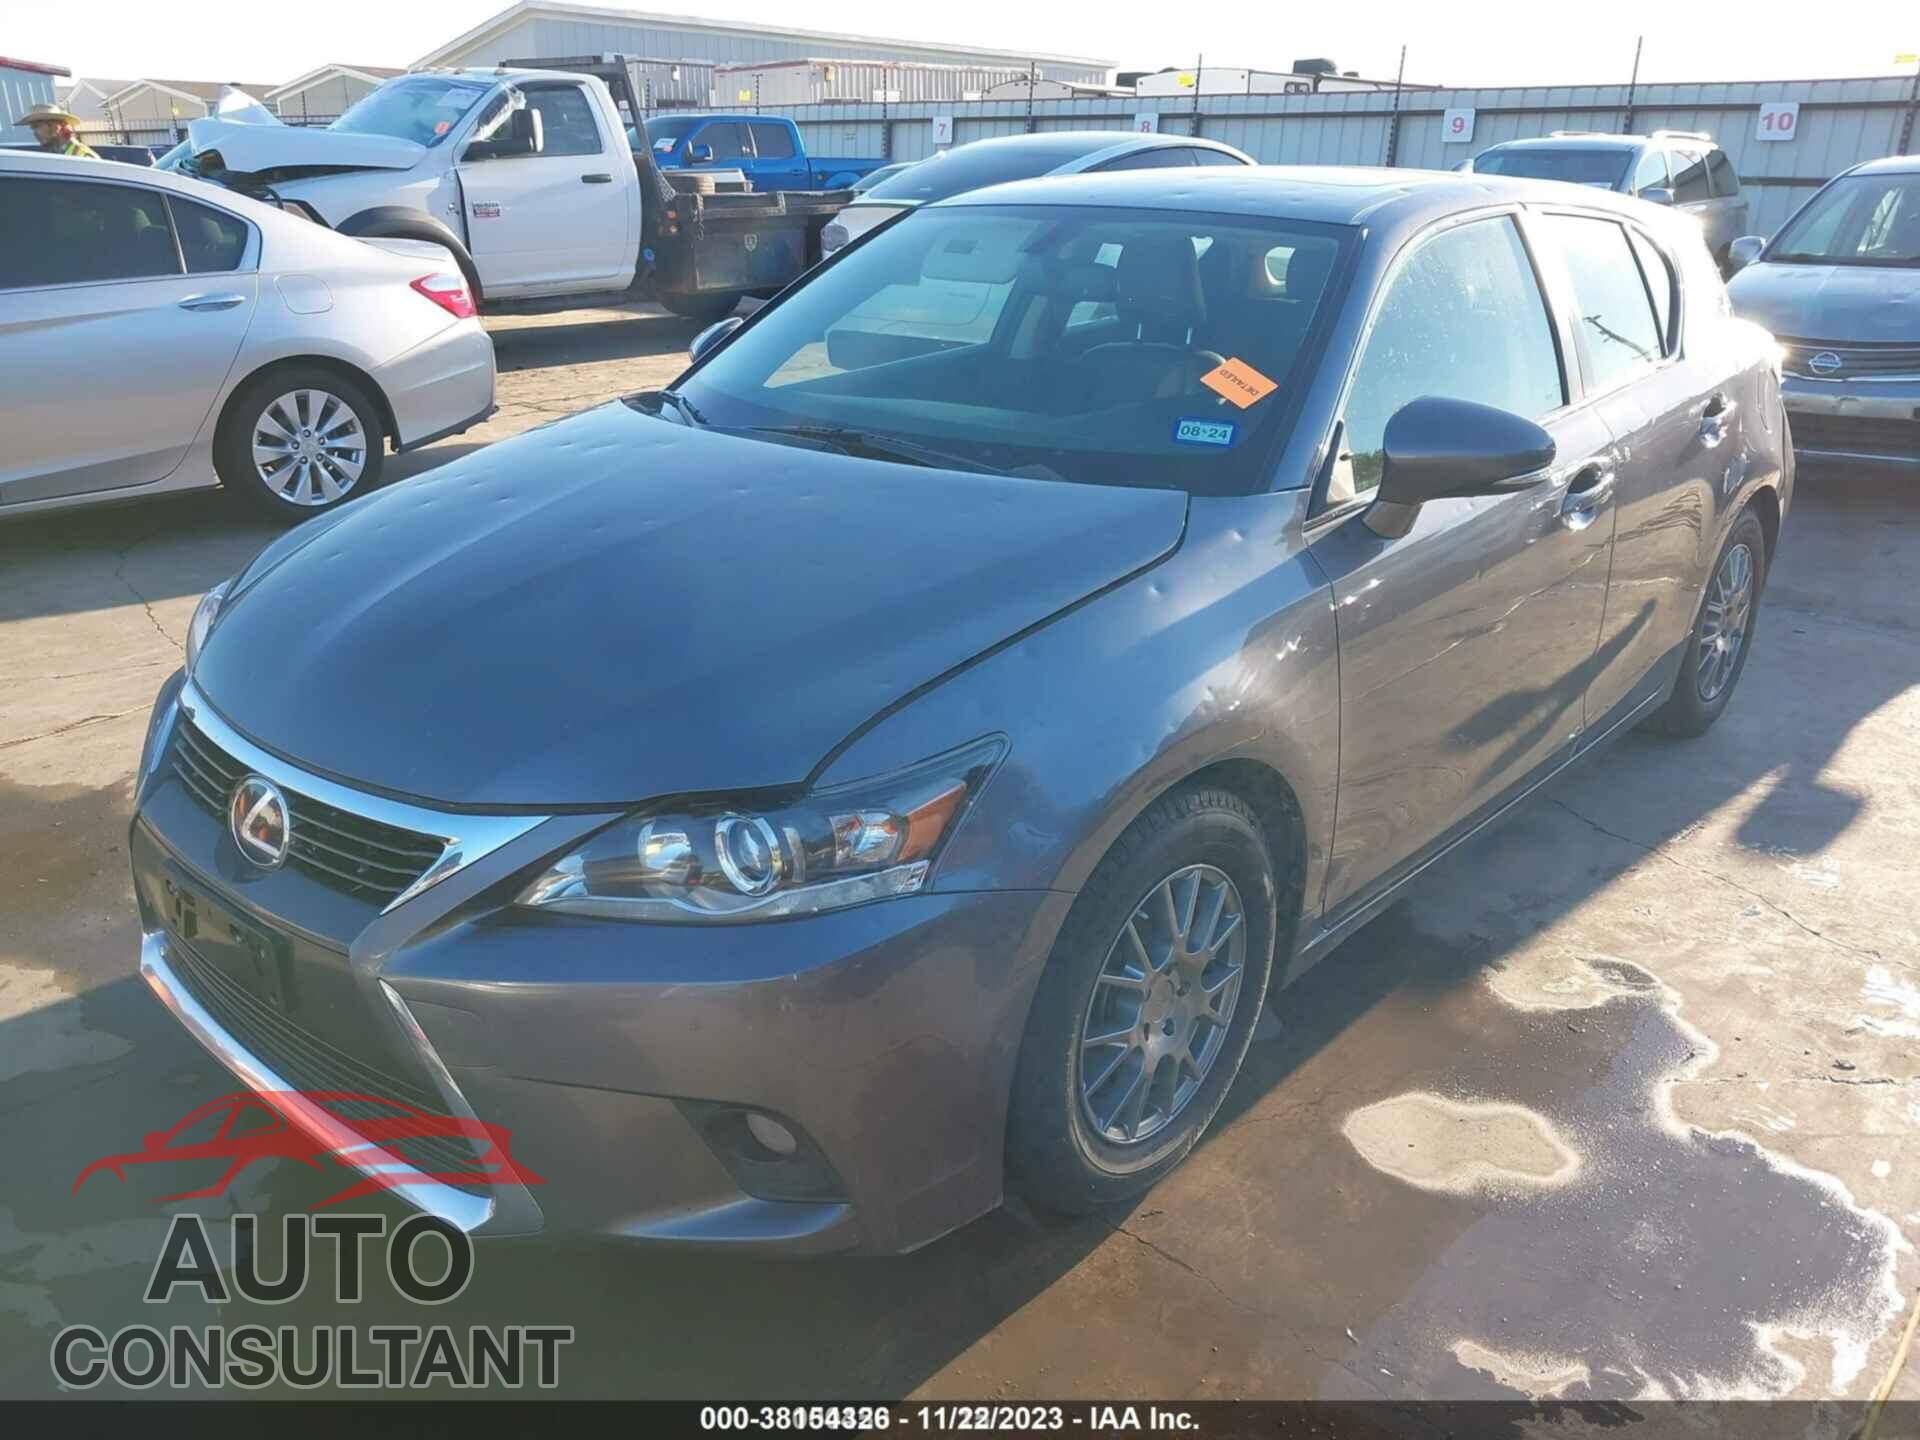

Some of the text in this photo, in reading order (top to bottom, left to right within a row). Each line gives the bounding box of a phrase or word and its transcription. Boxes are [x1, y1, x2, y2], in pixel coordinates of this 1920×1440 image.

[1140, 120, 1151, 133] 8
[1452, 117, 1464, 133] 9
[1763, 112, 1793, 131] 10
[938, 123, 946, 136] 7
